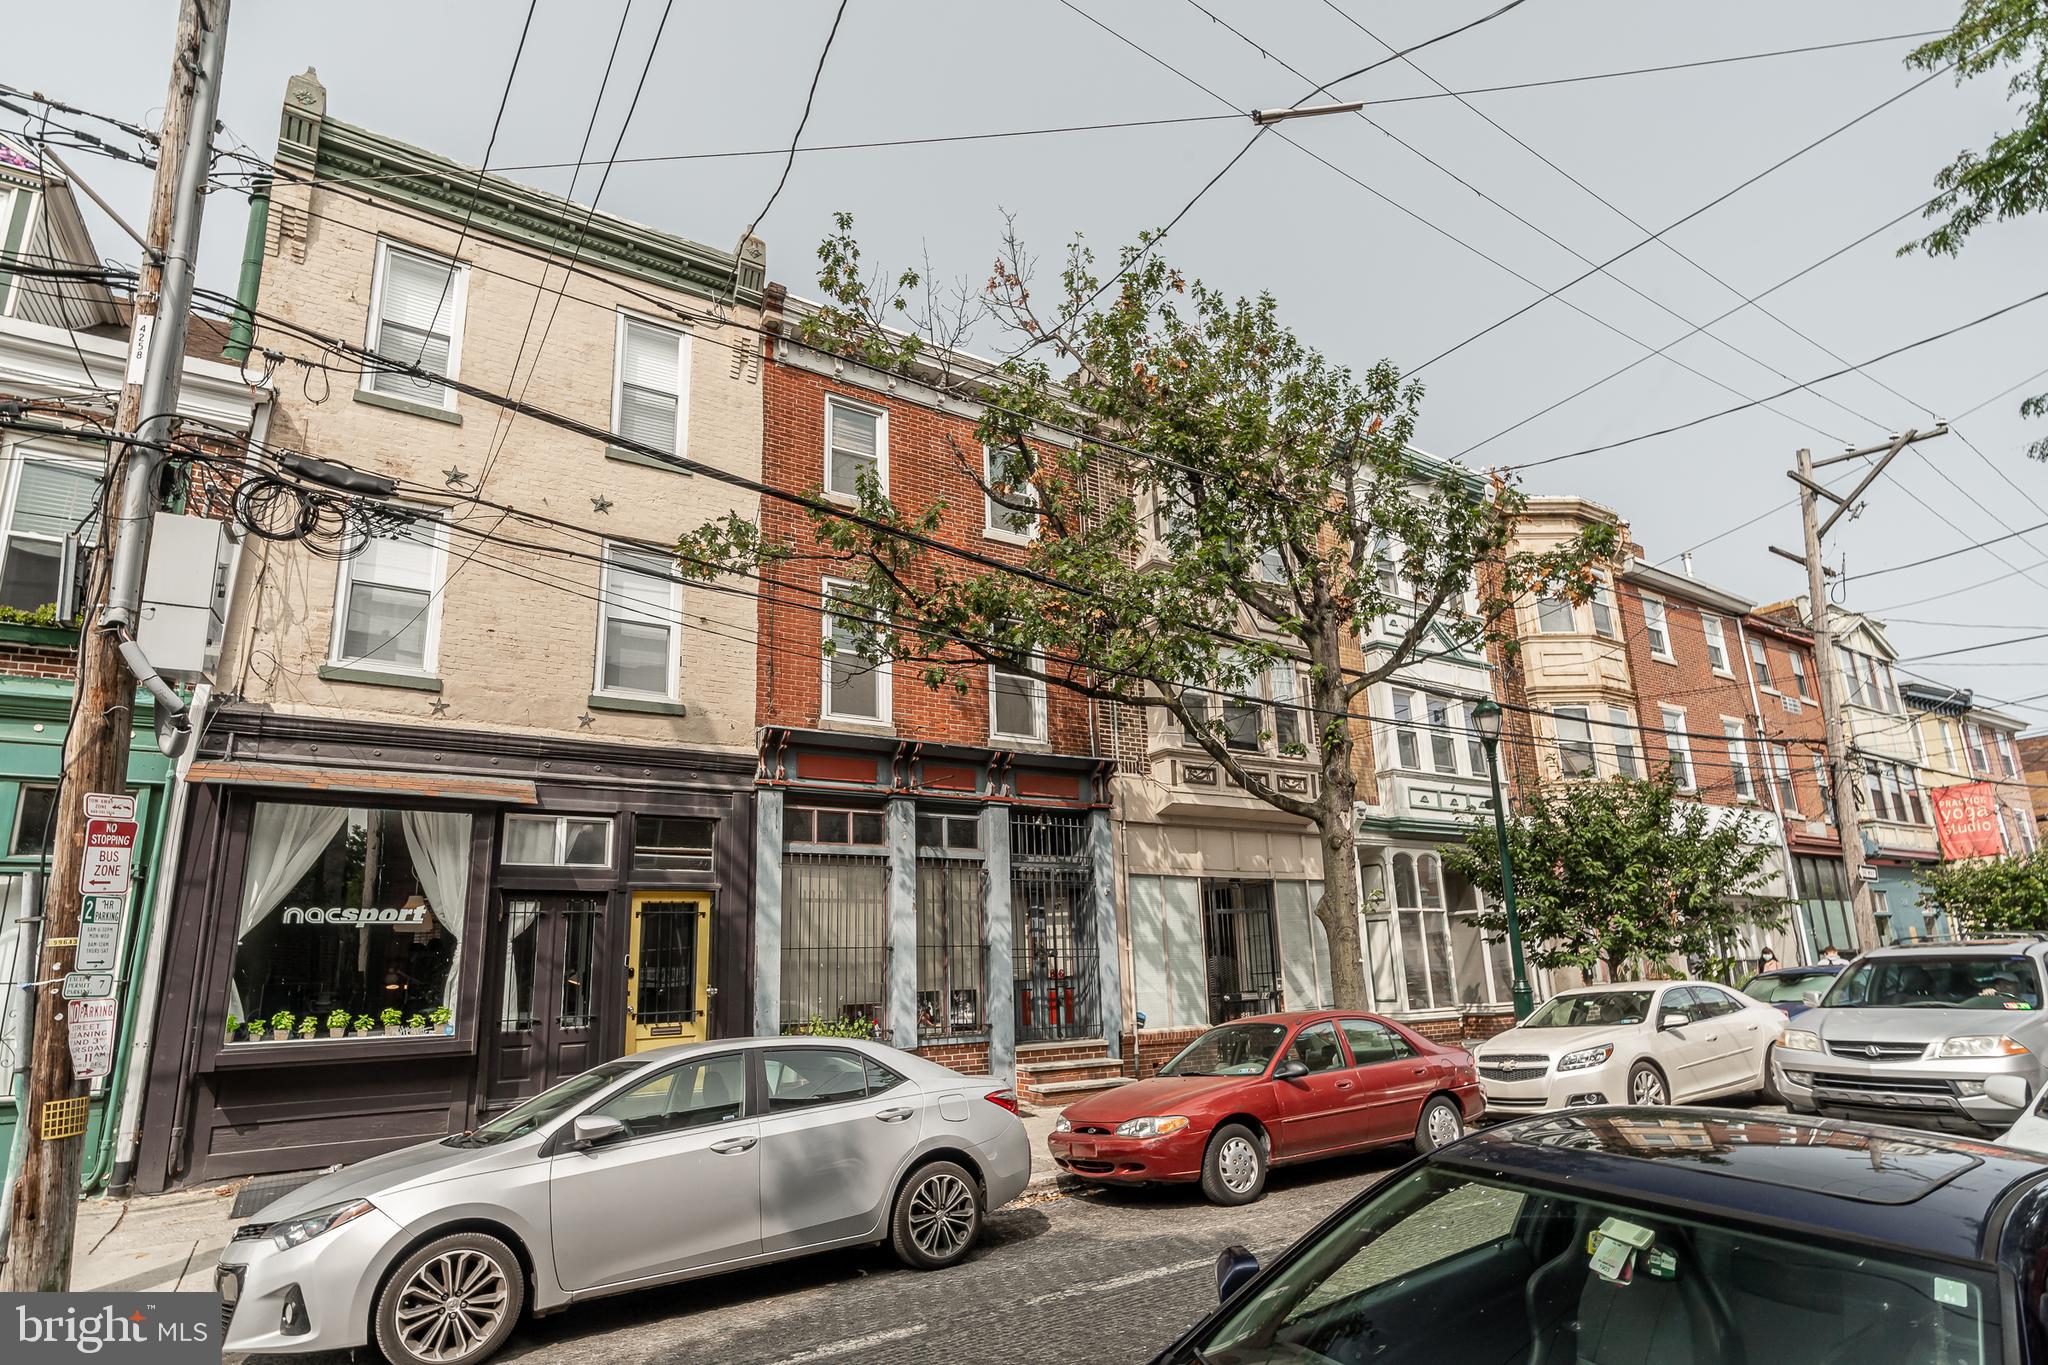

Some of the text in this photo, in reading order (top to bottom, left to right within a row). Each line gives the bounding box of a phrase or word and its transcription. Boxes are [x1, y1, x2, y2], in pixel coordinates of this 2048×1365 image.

[136, 324, 146, 360] 4258
[1940, 805, 1989, 824] yoga
[106, 823, 117, 833] NO
[1945, 820, 1992, 836] studio
[91, 834, 130, 845] STOPPING
[99, 850, 119, 863] BUS
[94, 864, 121, 877] ZONE
[85, 900, 115, 920] 2 HR
[95, 911, 120, 922] PARKING
[282, 904, 427, 928] nacsport
[99, 979, 105, 989] 7
[80, 1005, 113, 1018] PARKING
